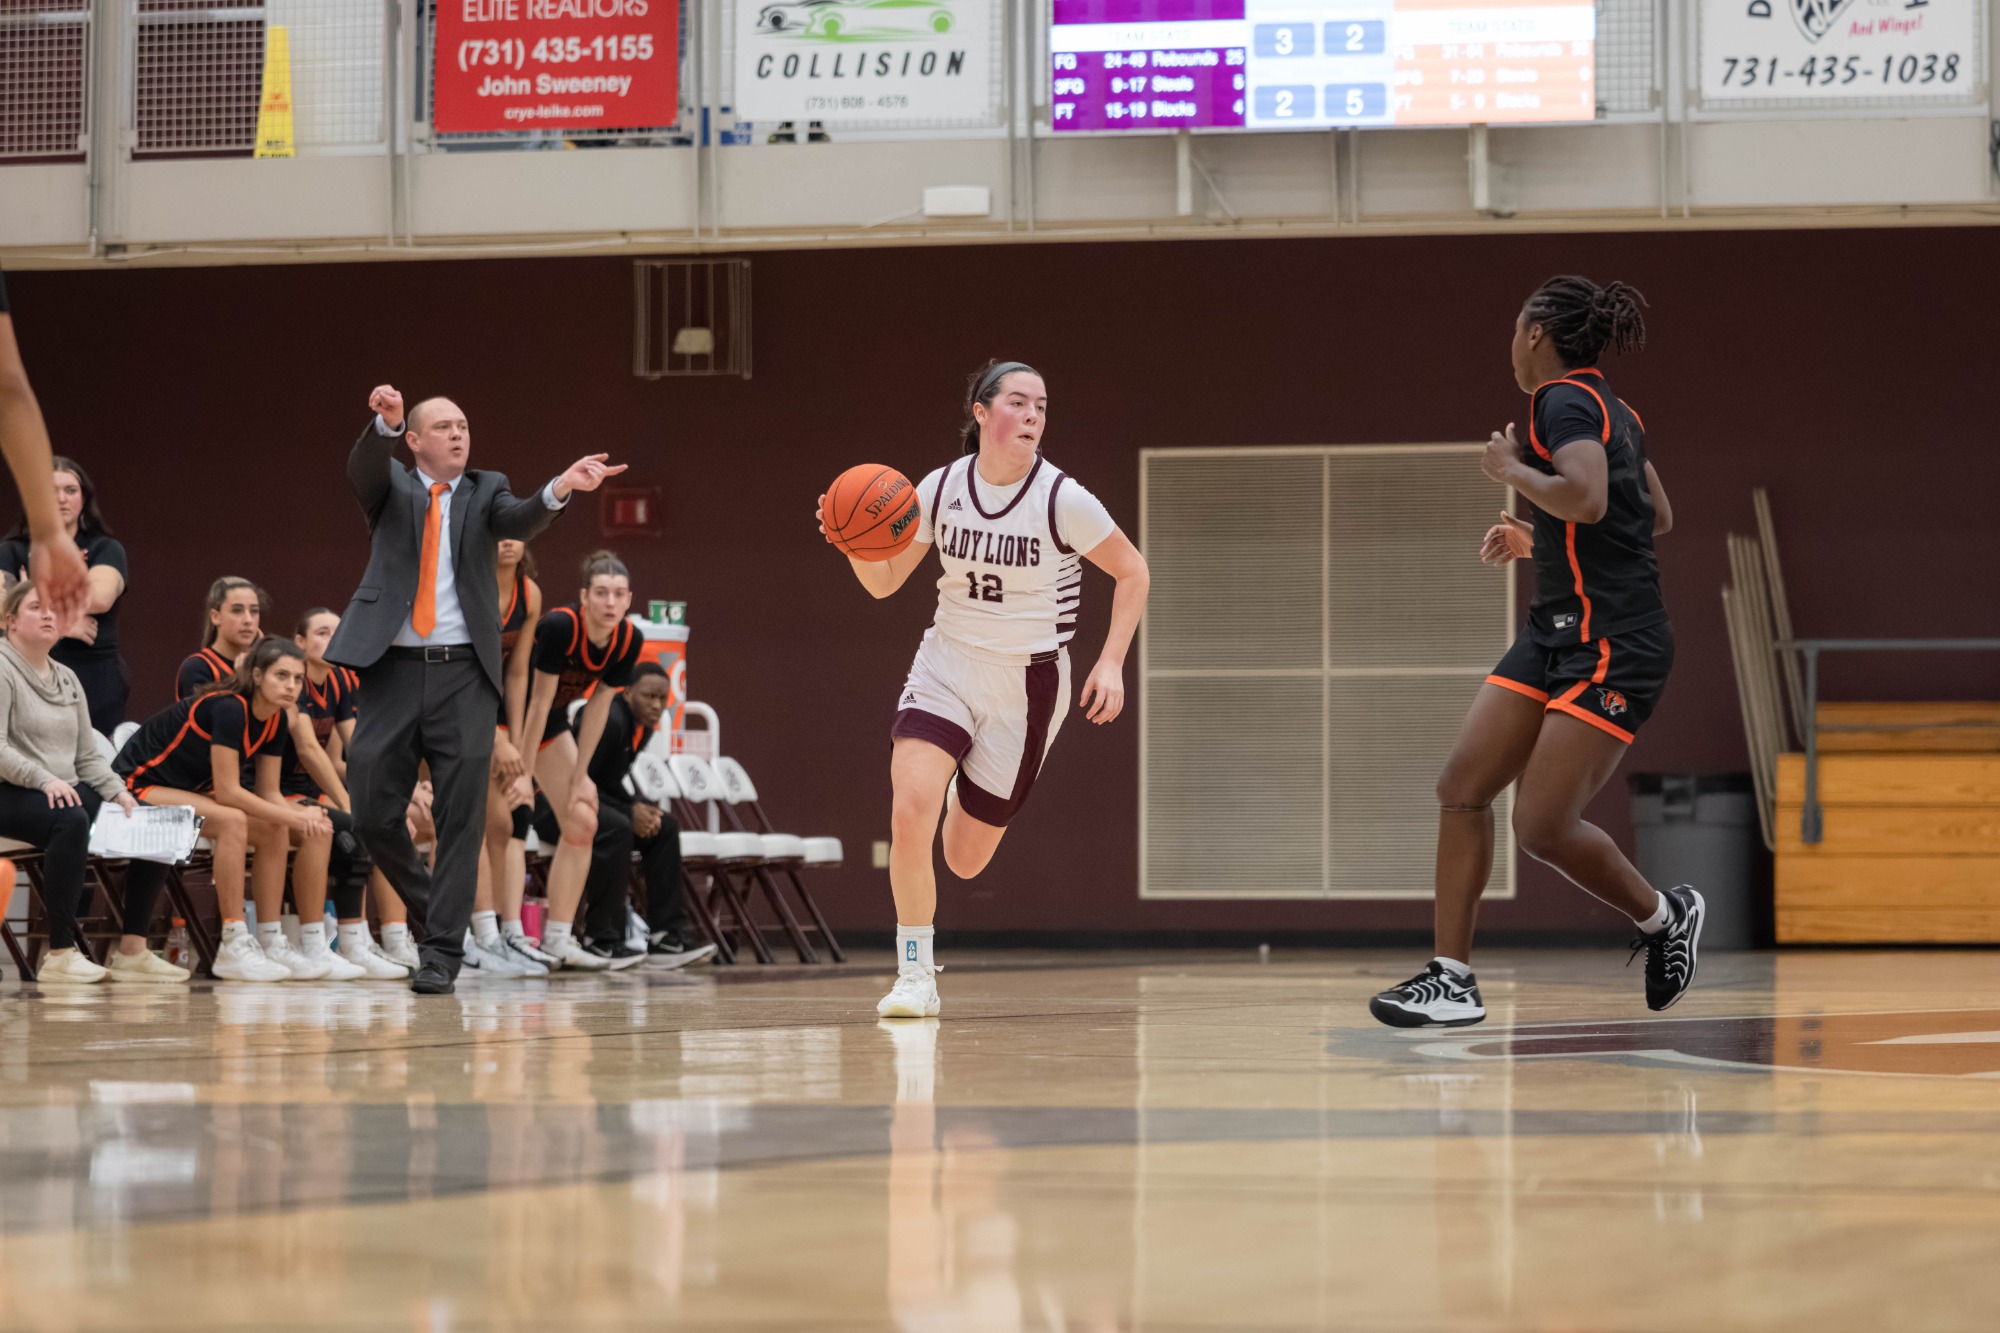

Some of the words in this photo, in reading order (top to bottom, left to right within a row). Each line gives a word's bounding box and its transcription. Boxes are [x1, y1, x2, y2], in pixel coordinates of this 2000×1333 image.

[462, 0, 519, 22] ELITE
[526, 0, 649, 20] REALTORS
[1275, 27, 1294, 55] 3
[1346, 23, 1364, 51] 2
[1848, 18, 1874, 37] And
[458, 37, 525, 72] (731)
[531, 34, 654, 63] 435-1155
[757, 50, 965, 79] COLLISION
[1054, 53, 1077, 70] FG
[1151, 49, 1219, 67] Rebounds
[1225, 49, 1244, 66] 25
[1721, 53, 1960, 87] 731-435-1038
[477, 75, 531, 97] John
[536, 73, 632, 97] Sweeney
[1054, 77, 1085, 95] 3FG
[1151, 75, 1194, 93] Steals
[504, 103, 605, 122] crye-leike.com
[804, 96, 839, 111] (731)
[1054, 102, 1076, 120] FT
[1151, 99, 1197, 118] Blocks
[1275, 89, 1294, 117] 2
[1346, 88, 1364, 116] 5
[941, 523, 983, 562] LADY
[983, 532, 1040, 567] LIONS
[966, 571, 1003, 603] 12
